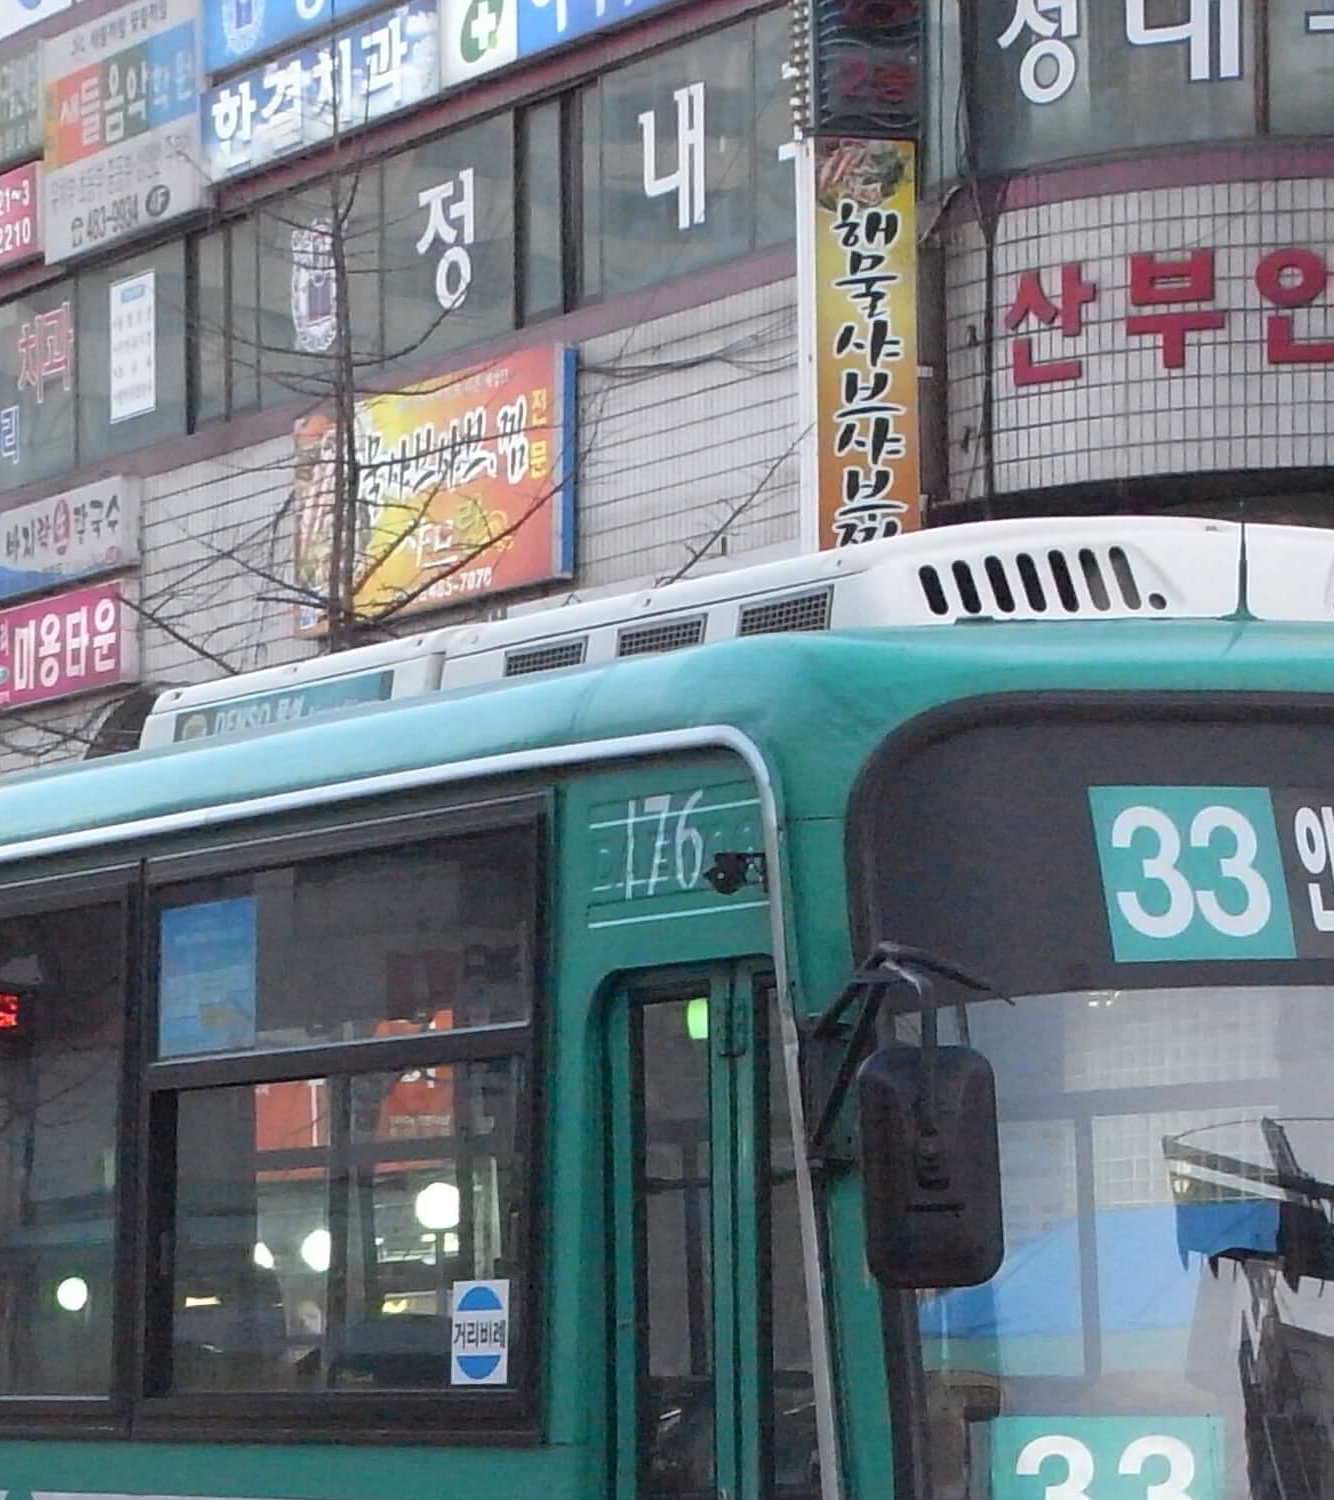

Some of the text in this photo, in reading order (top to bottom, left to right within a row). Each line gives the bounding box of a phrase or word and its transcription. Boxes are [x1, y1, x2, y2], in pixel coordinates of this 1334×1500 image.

[416, 82, 706, 309] 정 내
[14, 598, 118, 691] 미용타운
[624, 790, 704, 900] 176
[1110, 805, 1272, 938] 33
[452, 1318, 508, 1353] 거리비례
